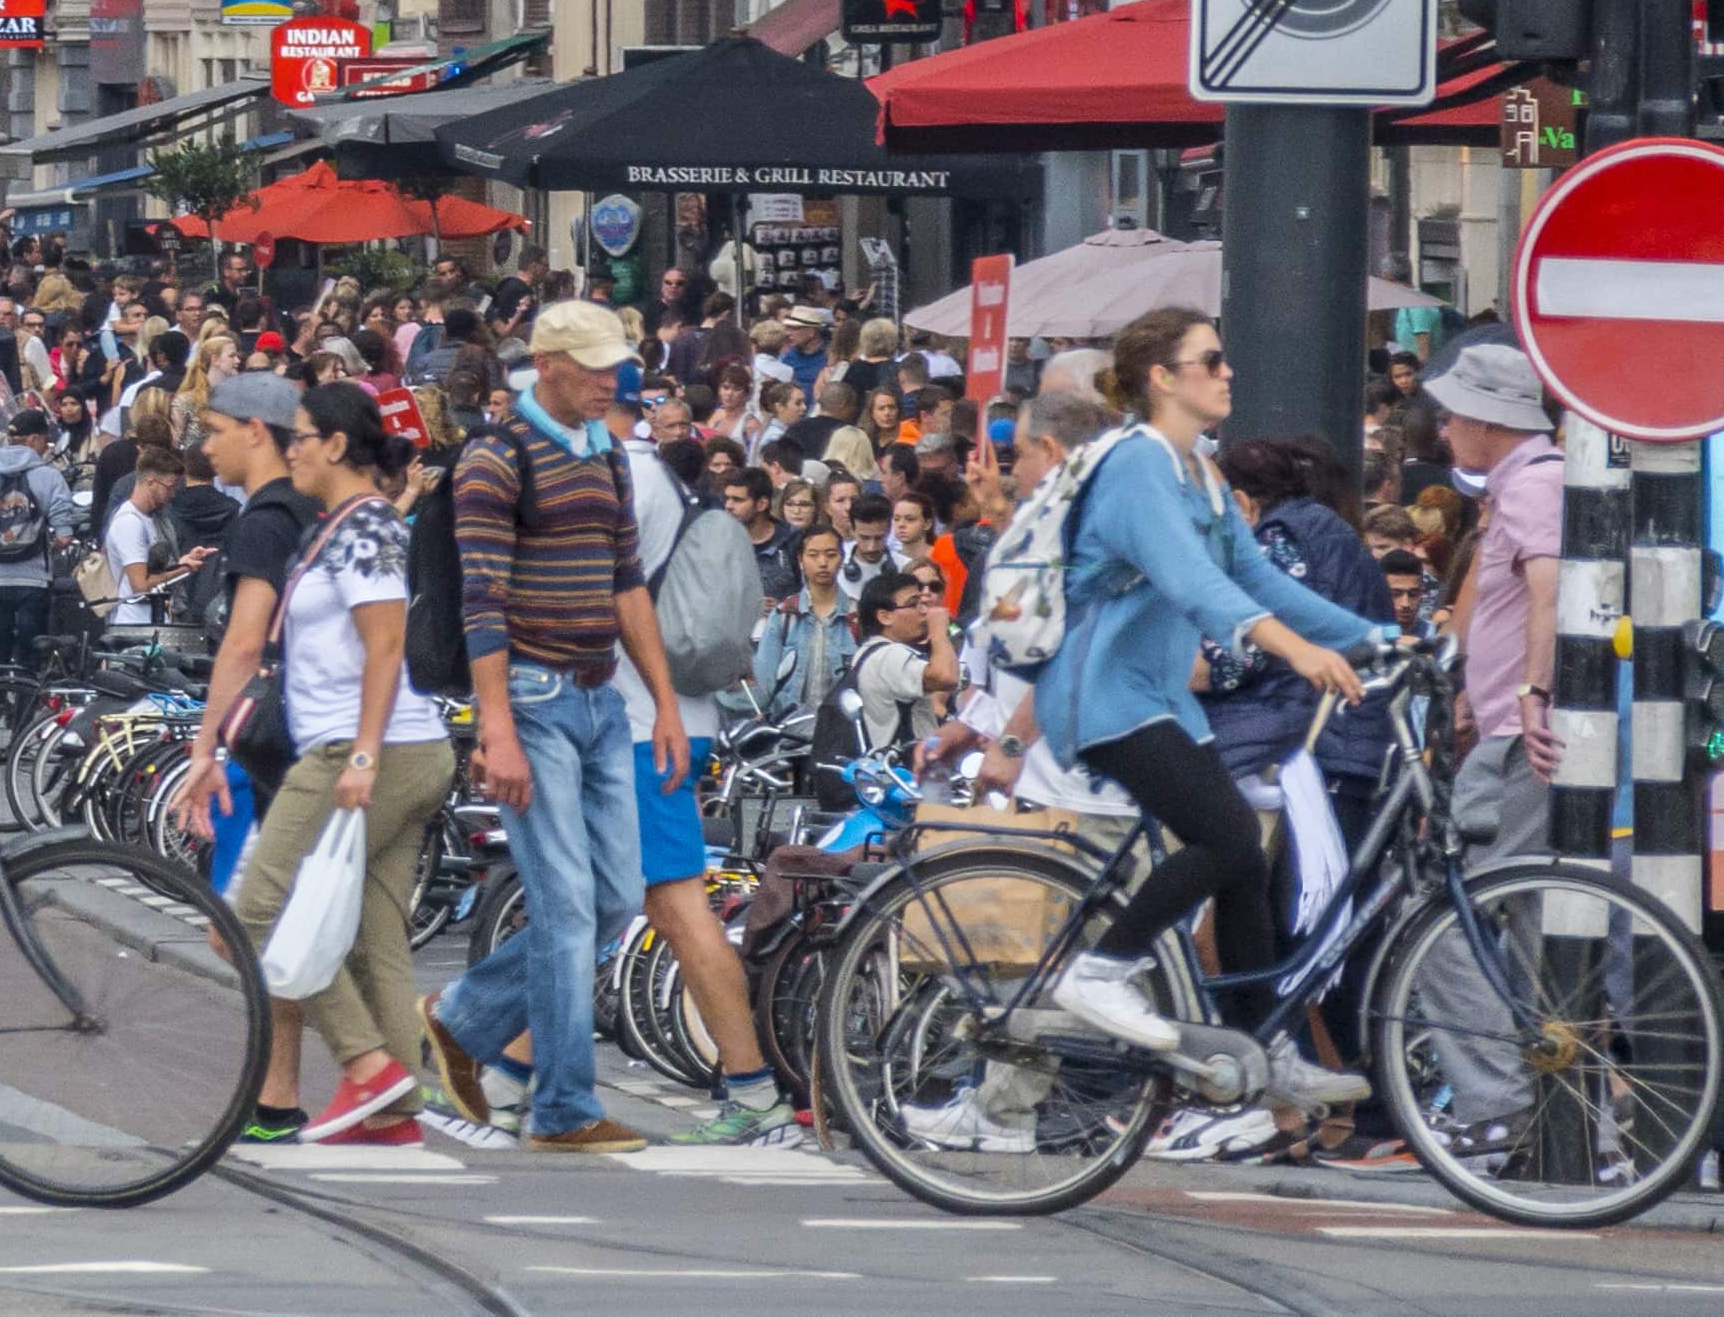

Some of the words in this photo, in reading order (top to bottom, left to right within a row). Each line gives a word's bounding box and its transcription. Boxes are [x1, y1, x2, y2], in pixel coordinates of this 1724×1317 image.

[287, 29, 355, 44] INDIAN
[281, 47, 360, 58] RESTAURANT
[628, 166, 732, 183] BRASSERIE
[734, 168, 750, 183] &
[755, 167, 813, 185] GRILL
[819, 169, 950, 188] RESTAURANT
